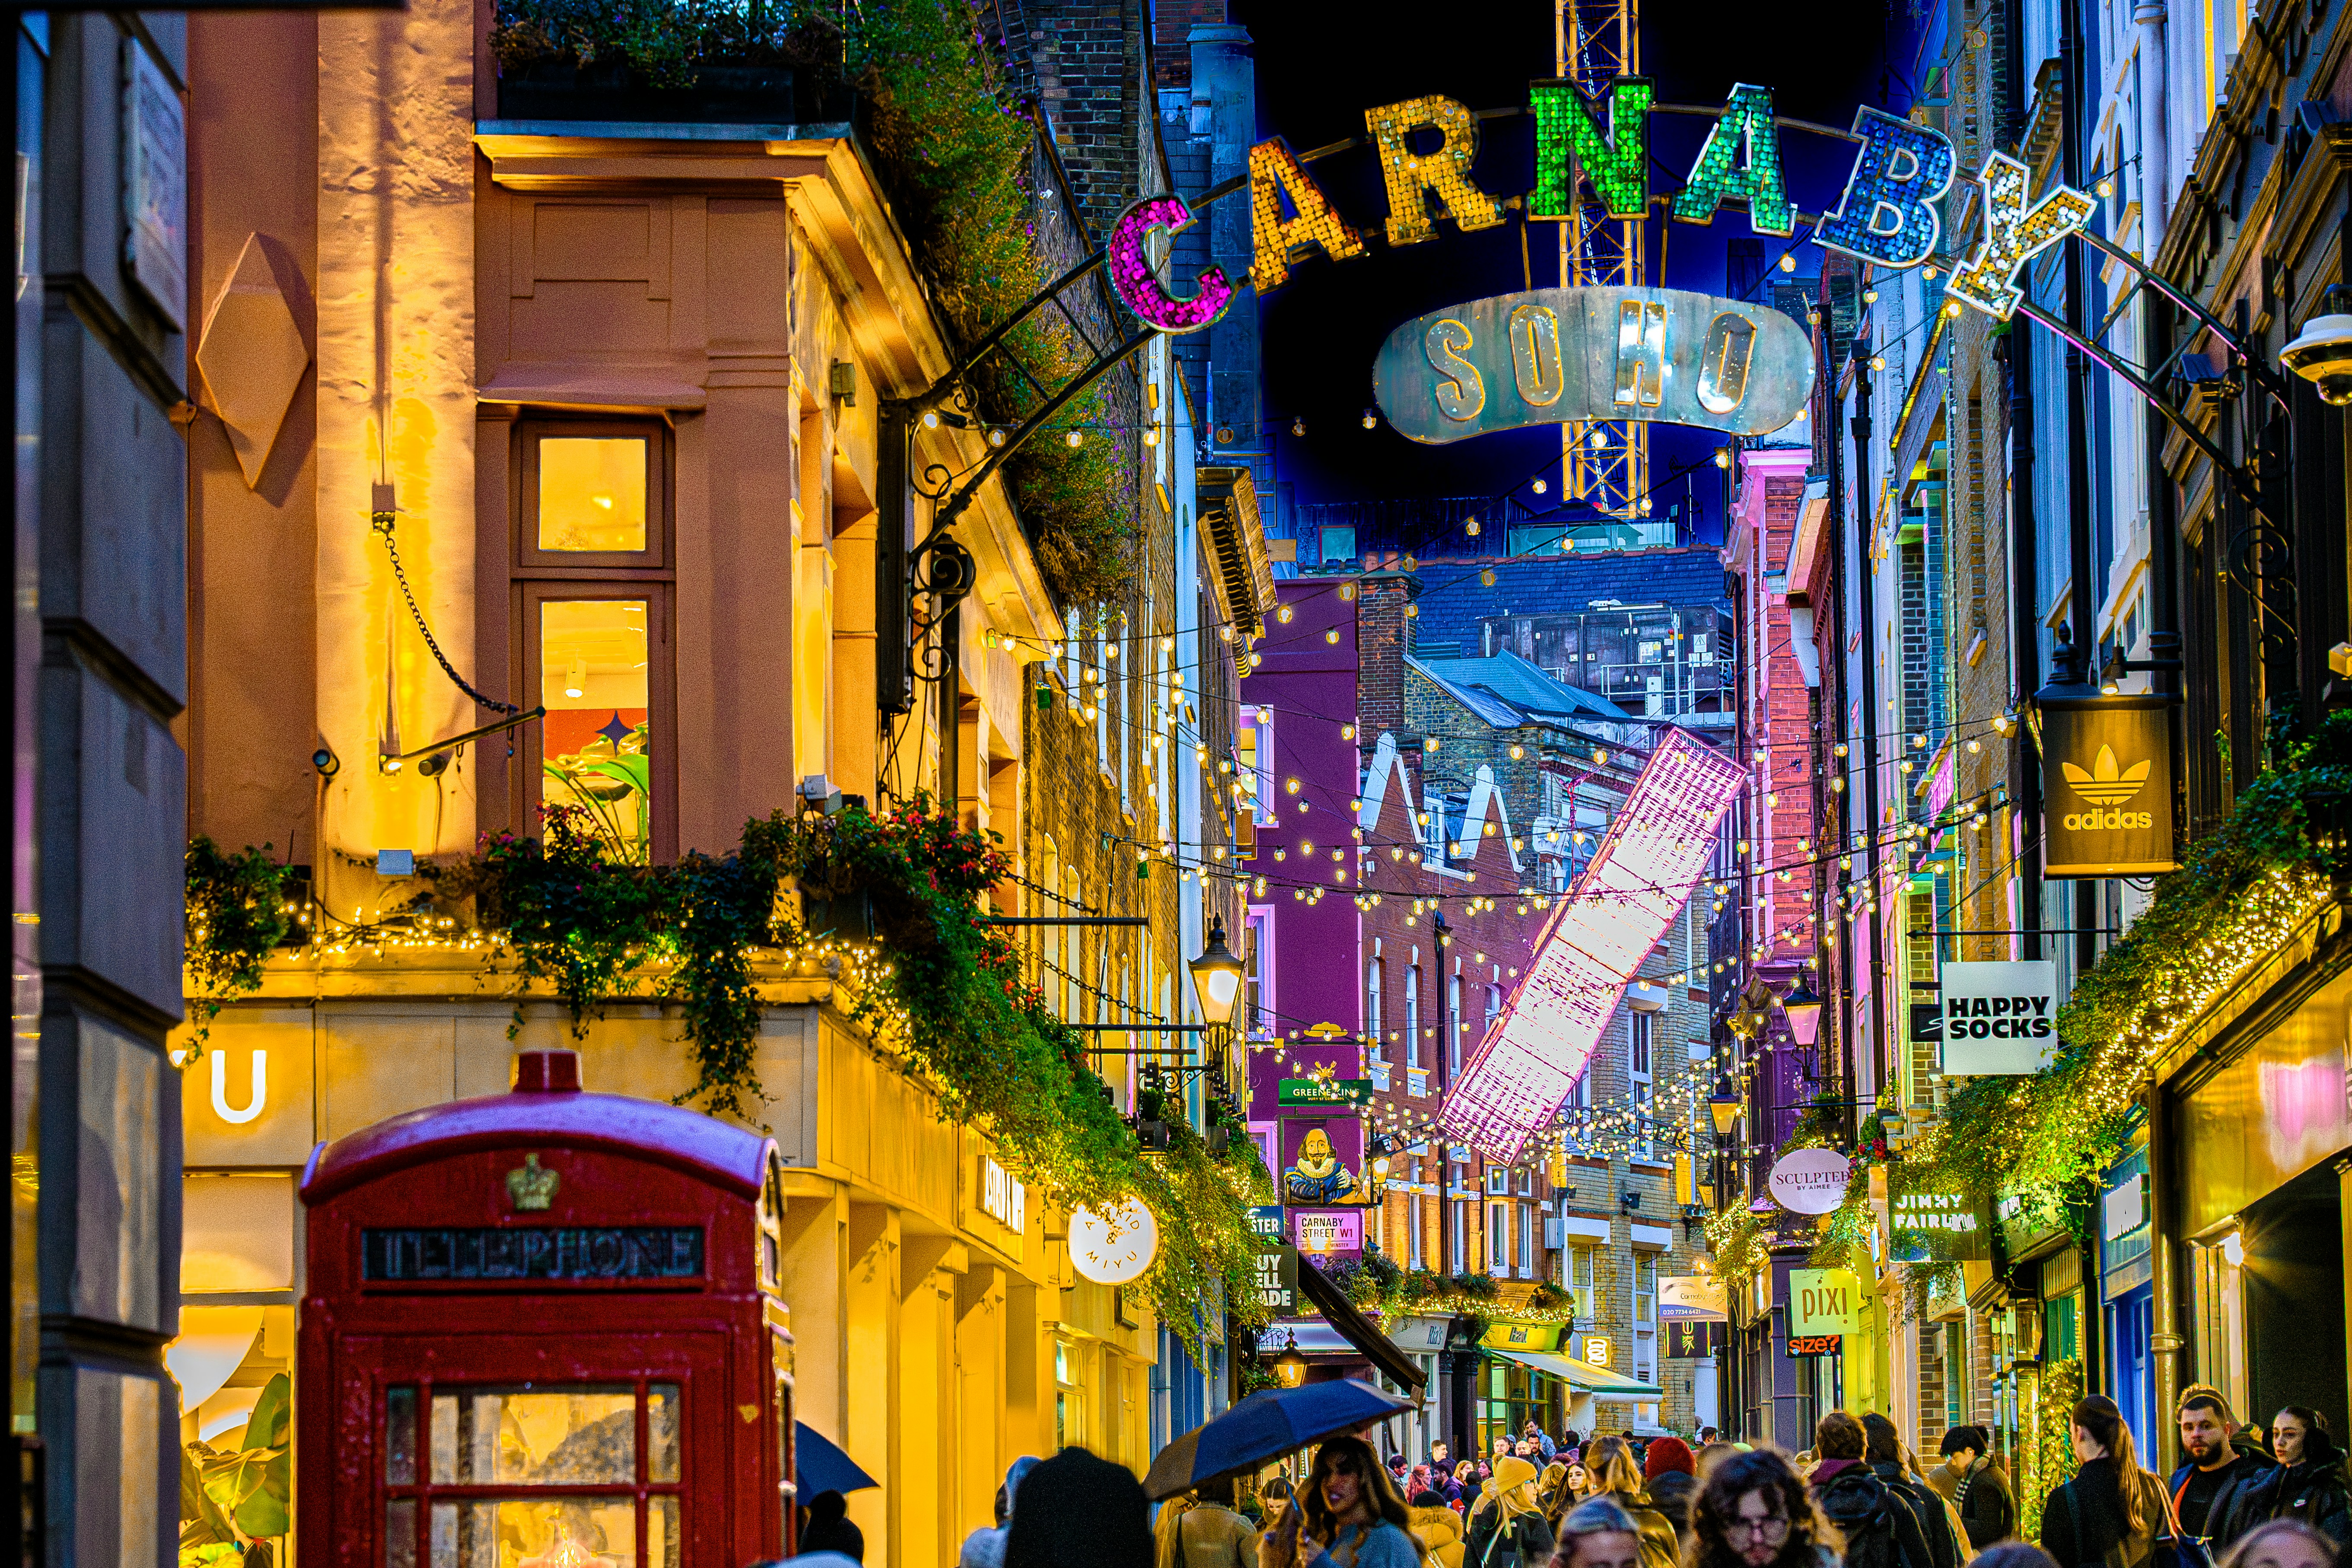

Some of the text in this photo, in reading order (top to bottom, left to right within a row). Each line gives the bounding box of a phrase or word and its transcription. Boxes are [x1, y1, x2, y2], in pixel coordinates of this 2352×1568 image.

[1106, 77, 2097, 333] CARNABY
[1424, 300, 1758, 420] SOHO
[2063, 807, 2153, 830] adidas
[1948, 996, 2050, 1018] HAPPY
[1949, 1018, 2051, 1040] SOCKS
[1293, 1088, 1359, 1097] GREENE KIN
[1776, 1171, 1850, 1185] SCULPTED
[1302, 1218, 1344, 1227] CARNABY
[1302, 1228, 1353, 1238] STREET W1
[379, 1231, 694, 1277] TELEPHONE
[1086, 1250, 1137, 1269] MIYU
[1256, 1254, 1282, 1271] UY
[1255, 1272, 1282, 1288] ELL
[1257, 1290, 1291, 1306] ADE
[1427, 1326, 1443, 1345] Ria's
[1789, 1335, 1840, 1353] size?
